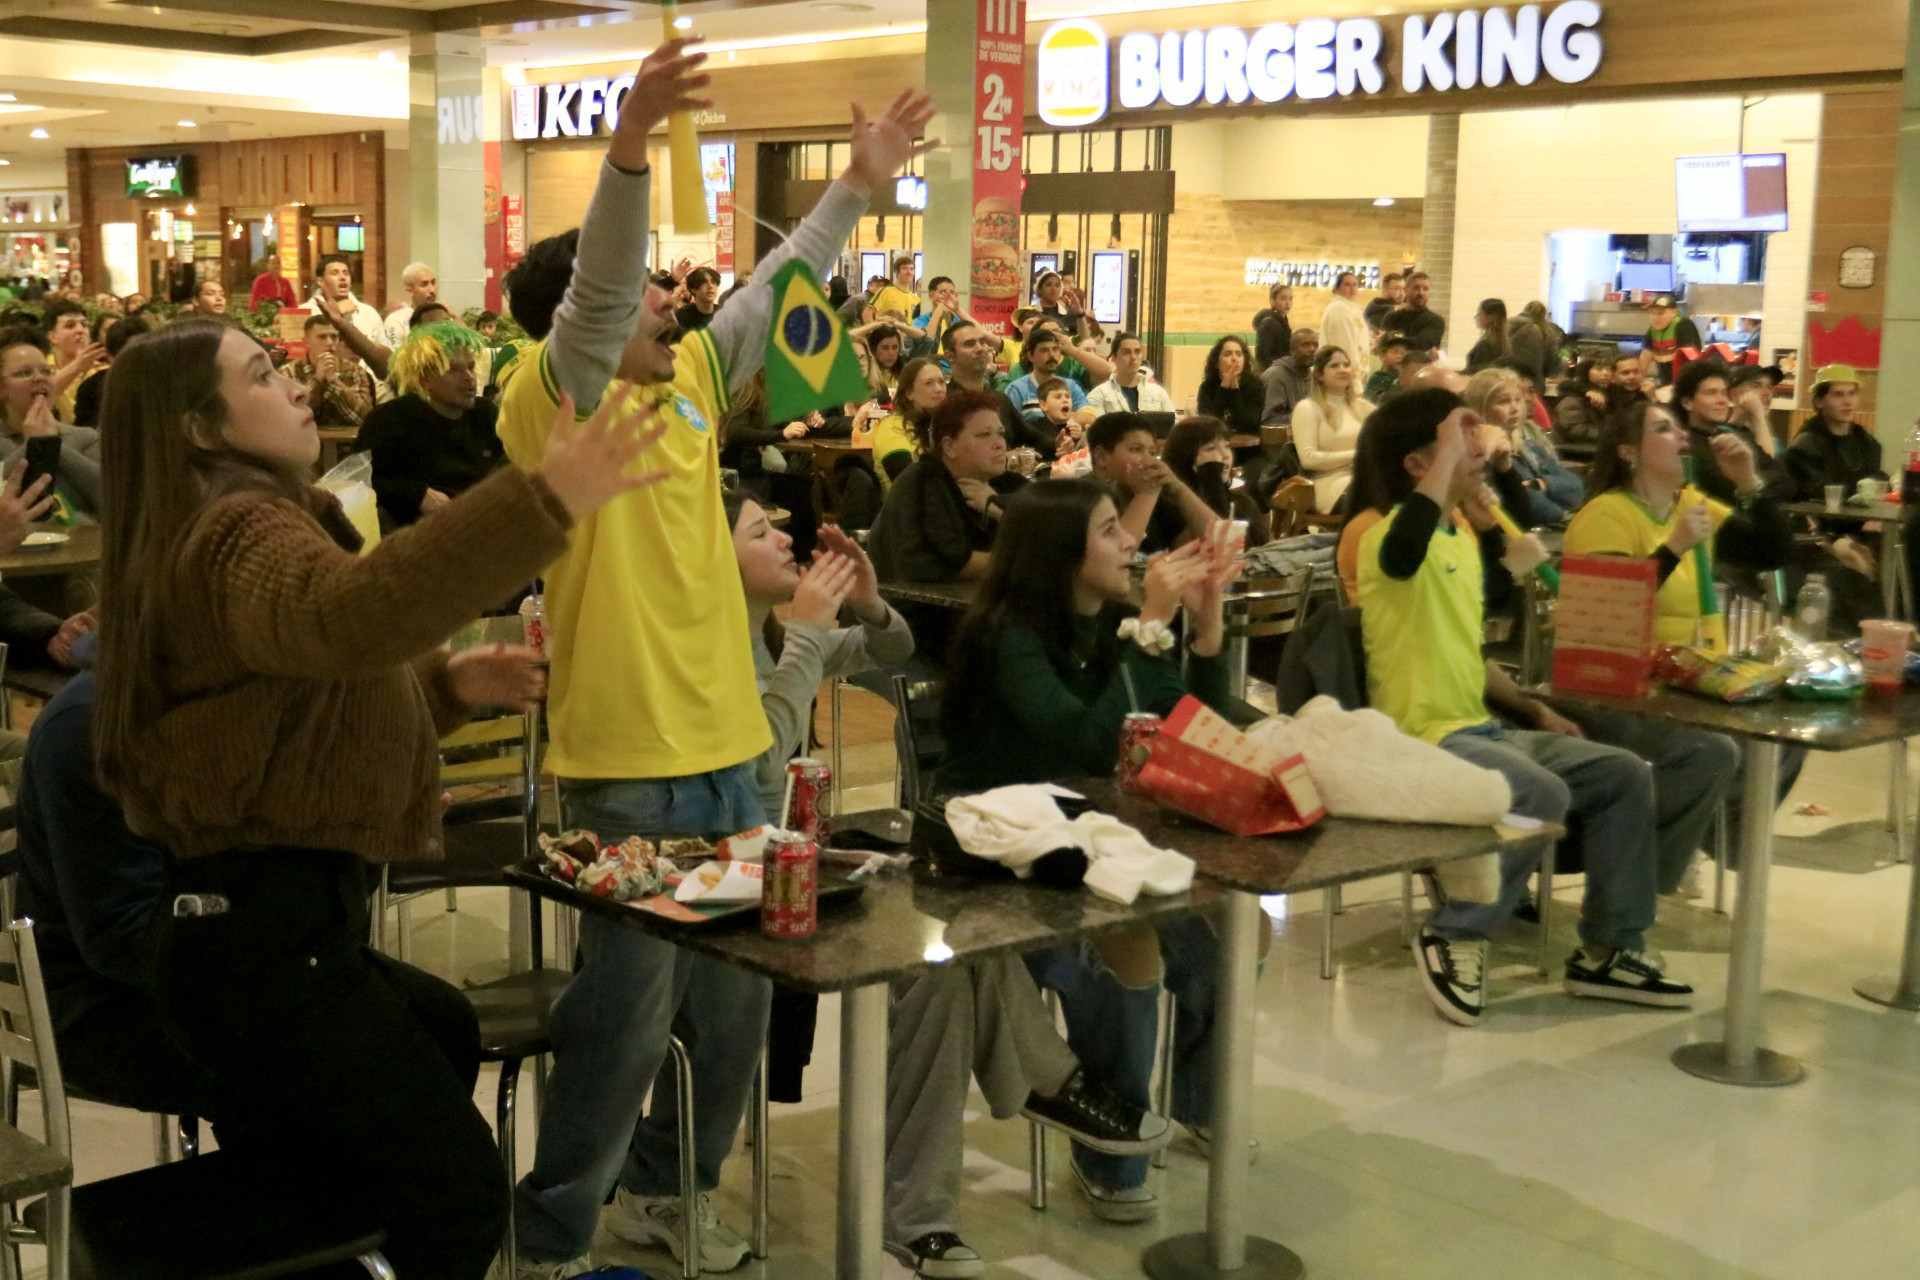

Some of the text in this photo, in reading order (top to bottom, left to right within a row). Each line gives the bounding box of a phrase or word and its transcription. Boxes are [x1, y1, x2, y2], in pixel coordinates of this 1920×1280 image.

[1120, 0, 1600, 107] BURGER KING
[983, 73, 1004, 121] 2
